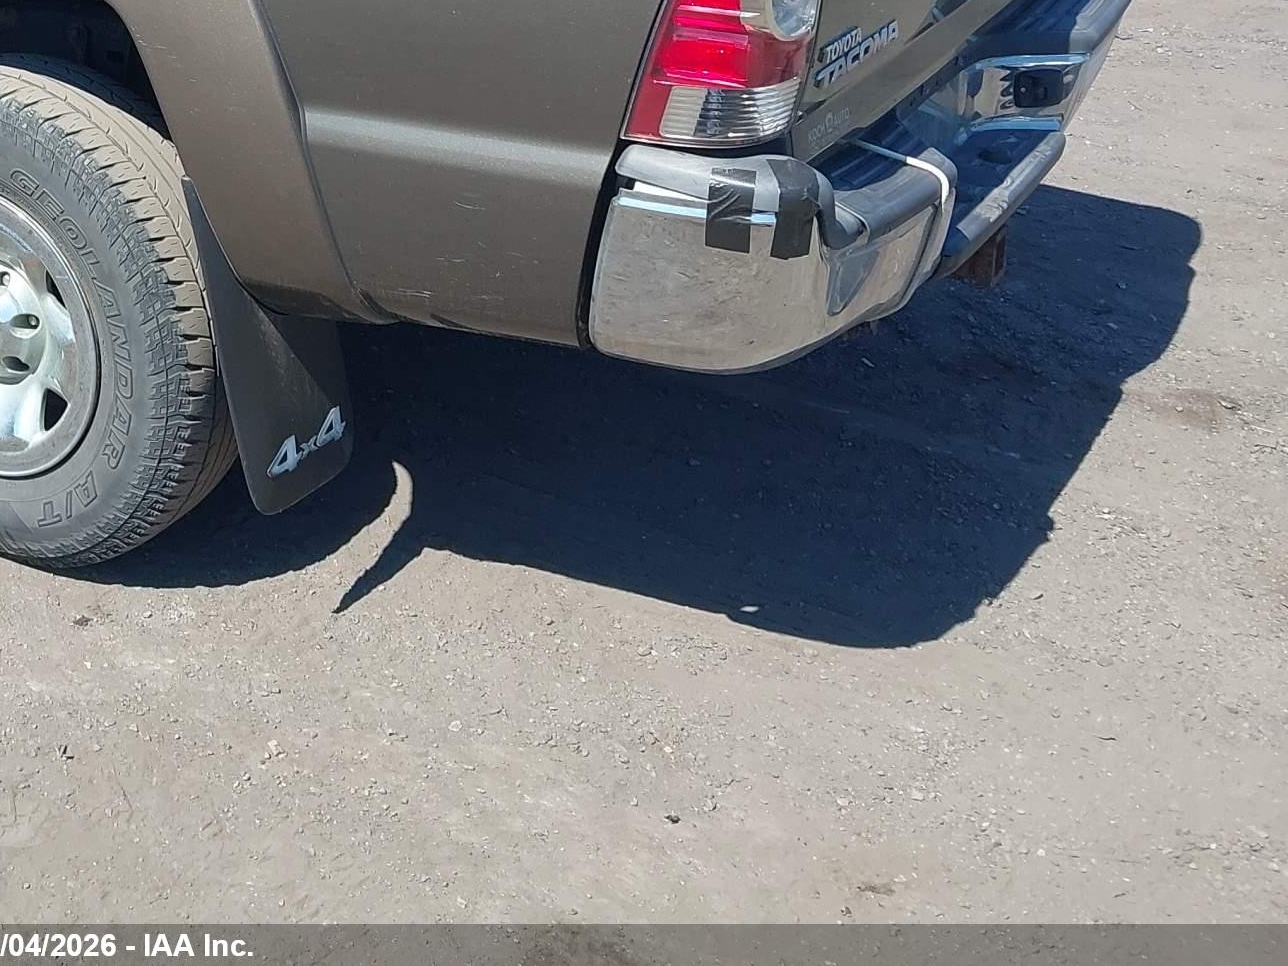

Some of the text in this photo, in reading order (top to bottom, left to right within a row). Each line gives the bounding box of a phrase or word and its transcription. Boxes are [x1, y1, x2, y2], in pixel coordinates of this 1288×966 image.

[815, 20, 899, 91] TACOMA
[824, 27, 863, 64] TOYOTA
[10, 168, 136, 470] GEOLANDAR
